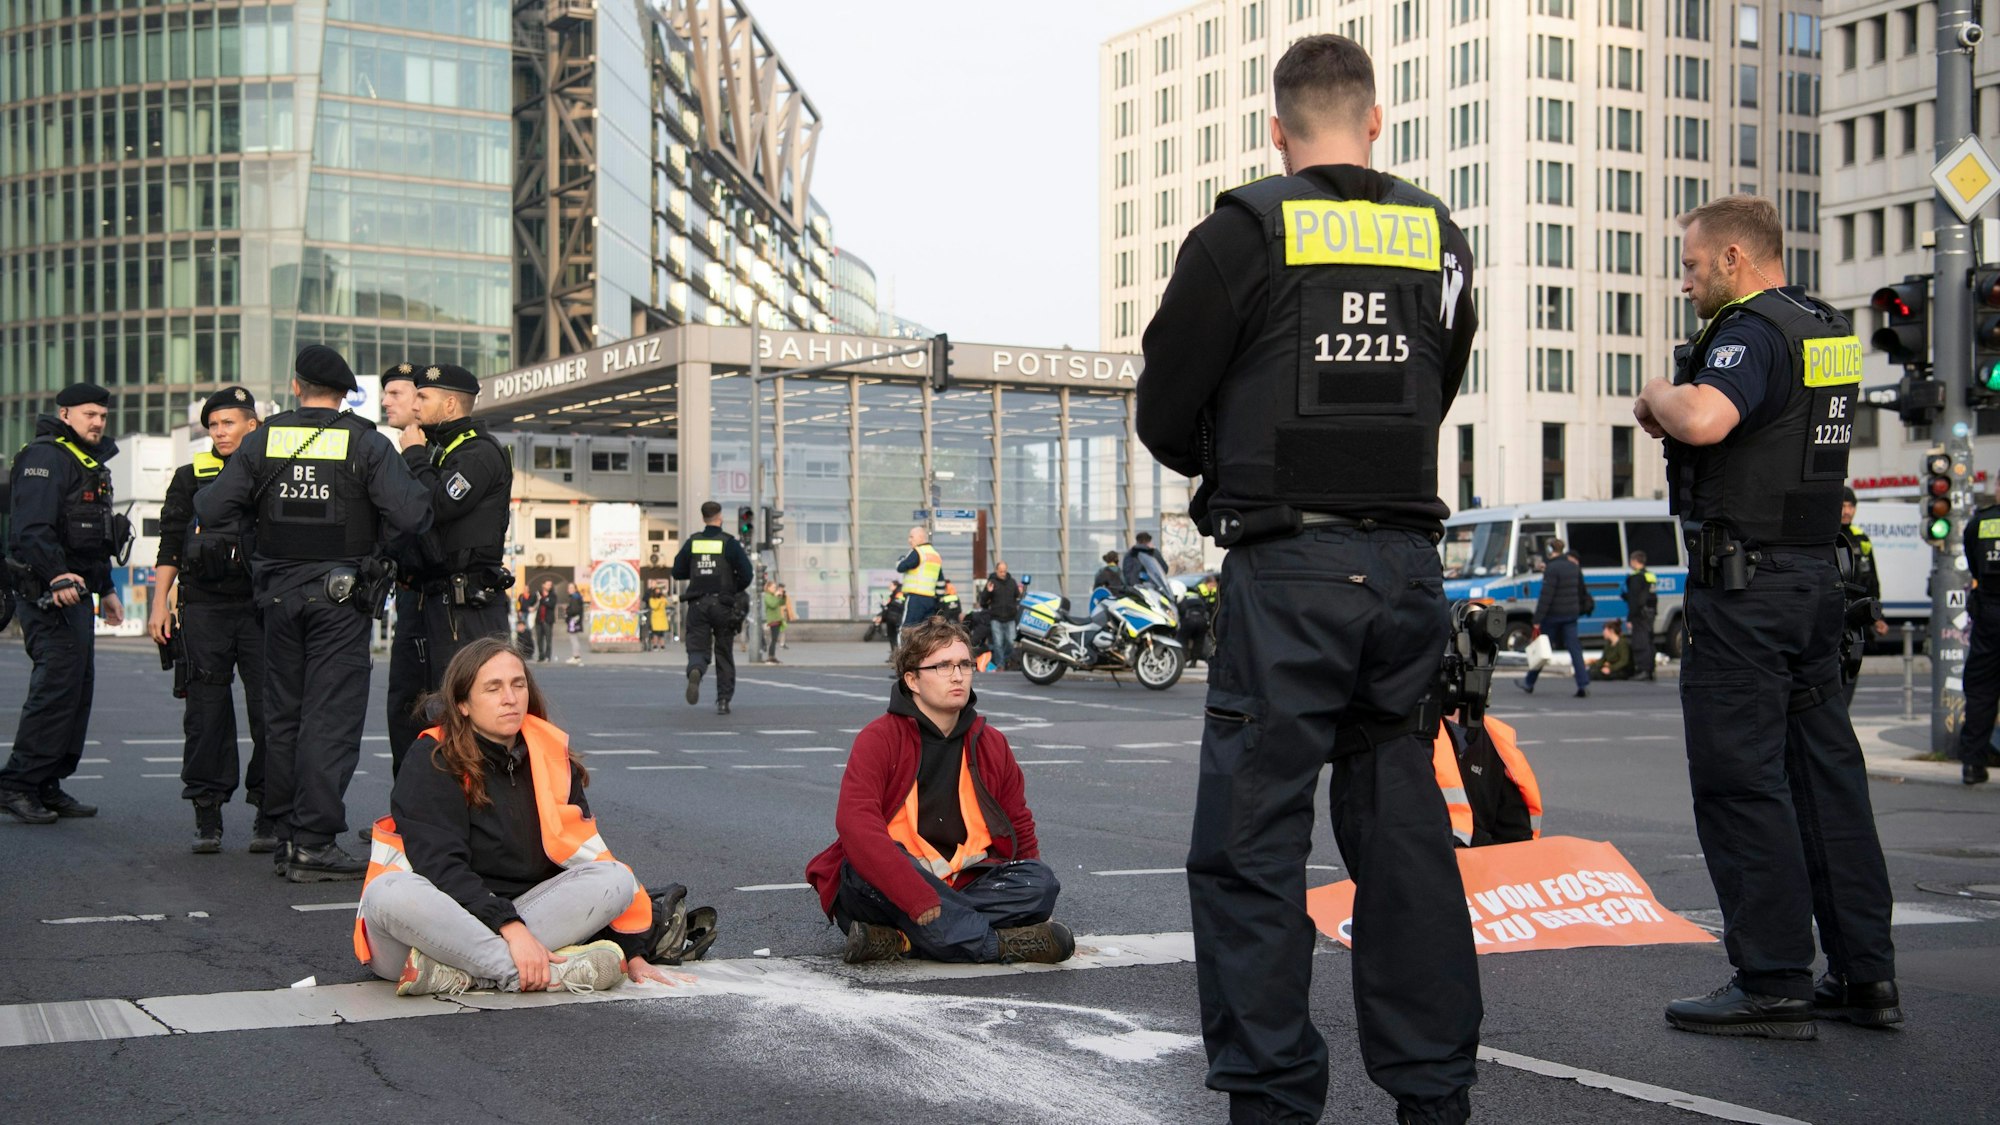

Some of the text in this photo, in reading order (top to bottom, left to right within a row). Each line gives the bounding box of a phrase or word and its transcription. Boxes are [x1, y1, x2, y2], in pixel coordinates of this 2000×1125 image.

[1294, 210, 1433, 260] POLIZEI
[1342, 291, 1388, 325] BE
[758, 334, 925, 368] BAHNHO
[1314, 333, 1410, 363] 12215
[1810, 343, 1862, 380] POLIZEI
[494, 337, 662, 400] POTSDAMER PLATZ
[993, 350, 1139, 382] POTSDA
[1828, 396, 1848, 419] BE
[1814, 424, 1852, 445] 12216
[24, 467, 50, 478] POLIZEI
[293, 465, 316, 482] BE
[1859, 523, 1919, 538] DEBRANDT
[592, 613, 639, 636] NOW
[1022, 615, 1049, 630] POLIZEI
[1473, 882, 1547, 917] VON
[1539, 869, 1644, 907] FOSSIL
[1484, 913, 1537, 944] ZU
[1530, 895, 1665, 930] GERECHT
